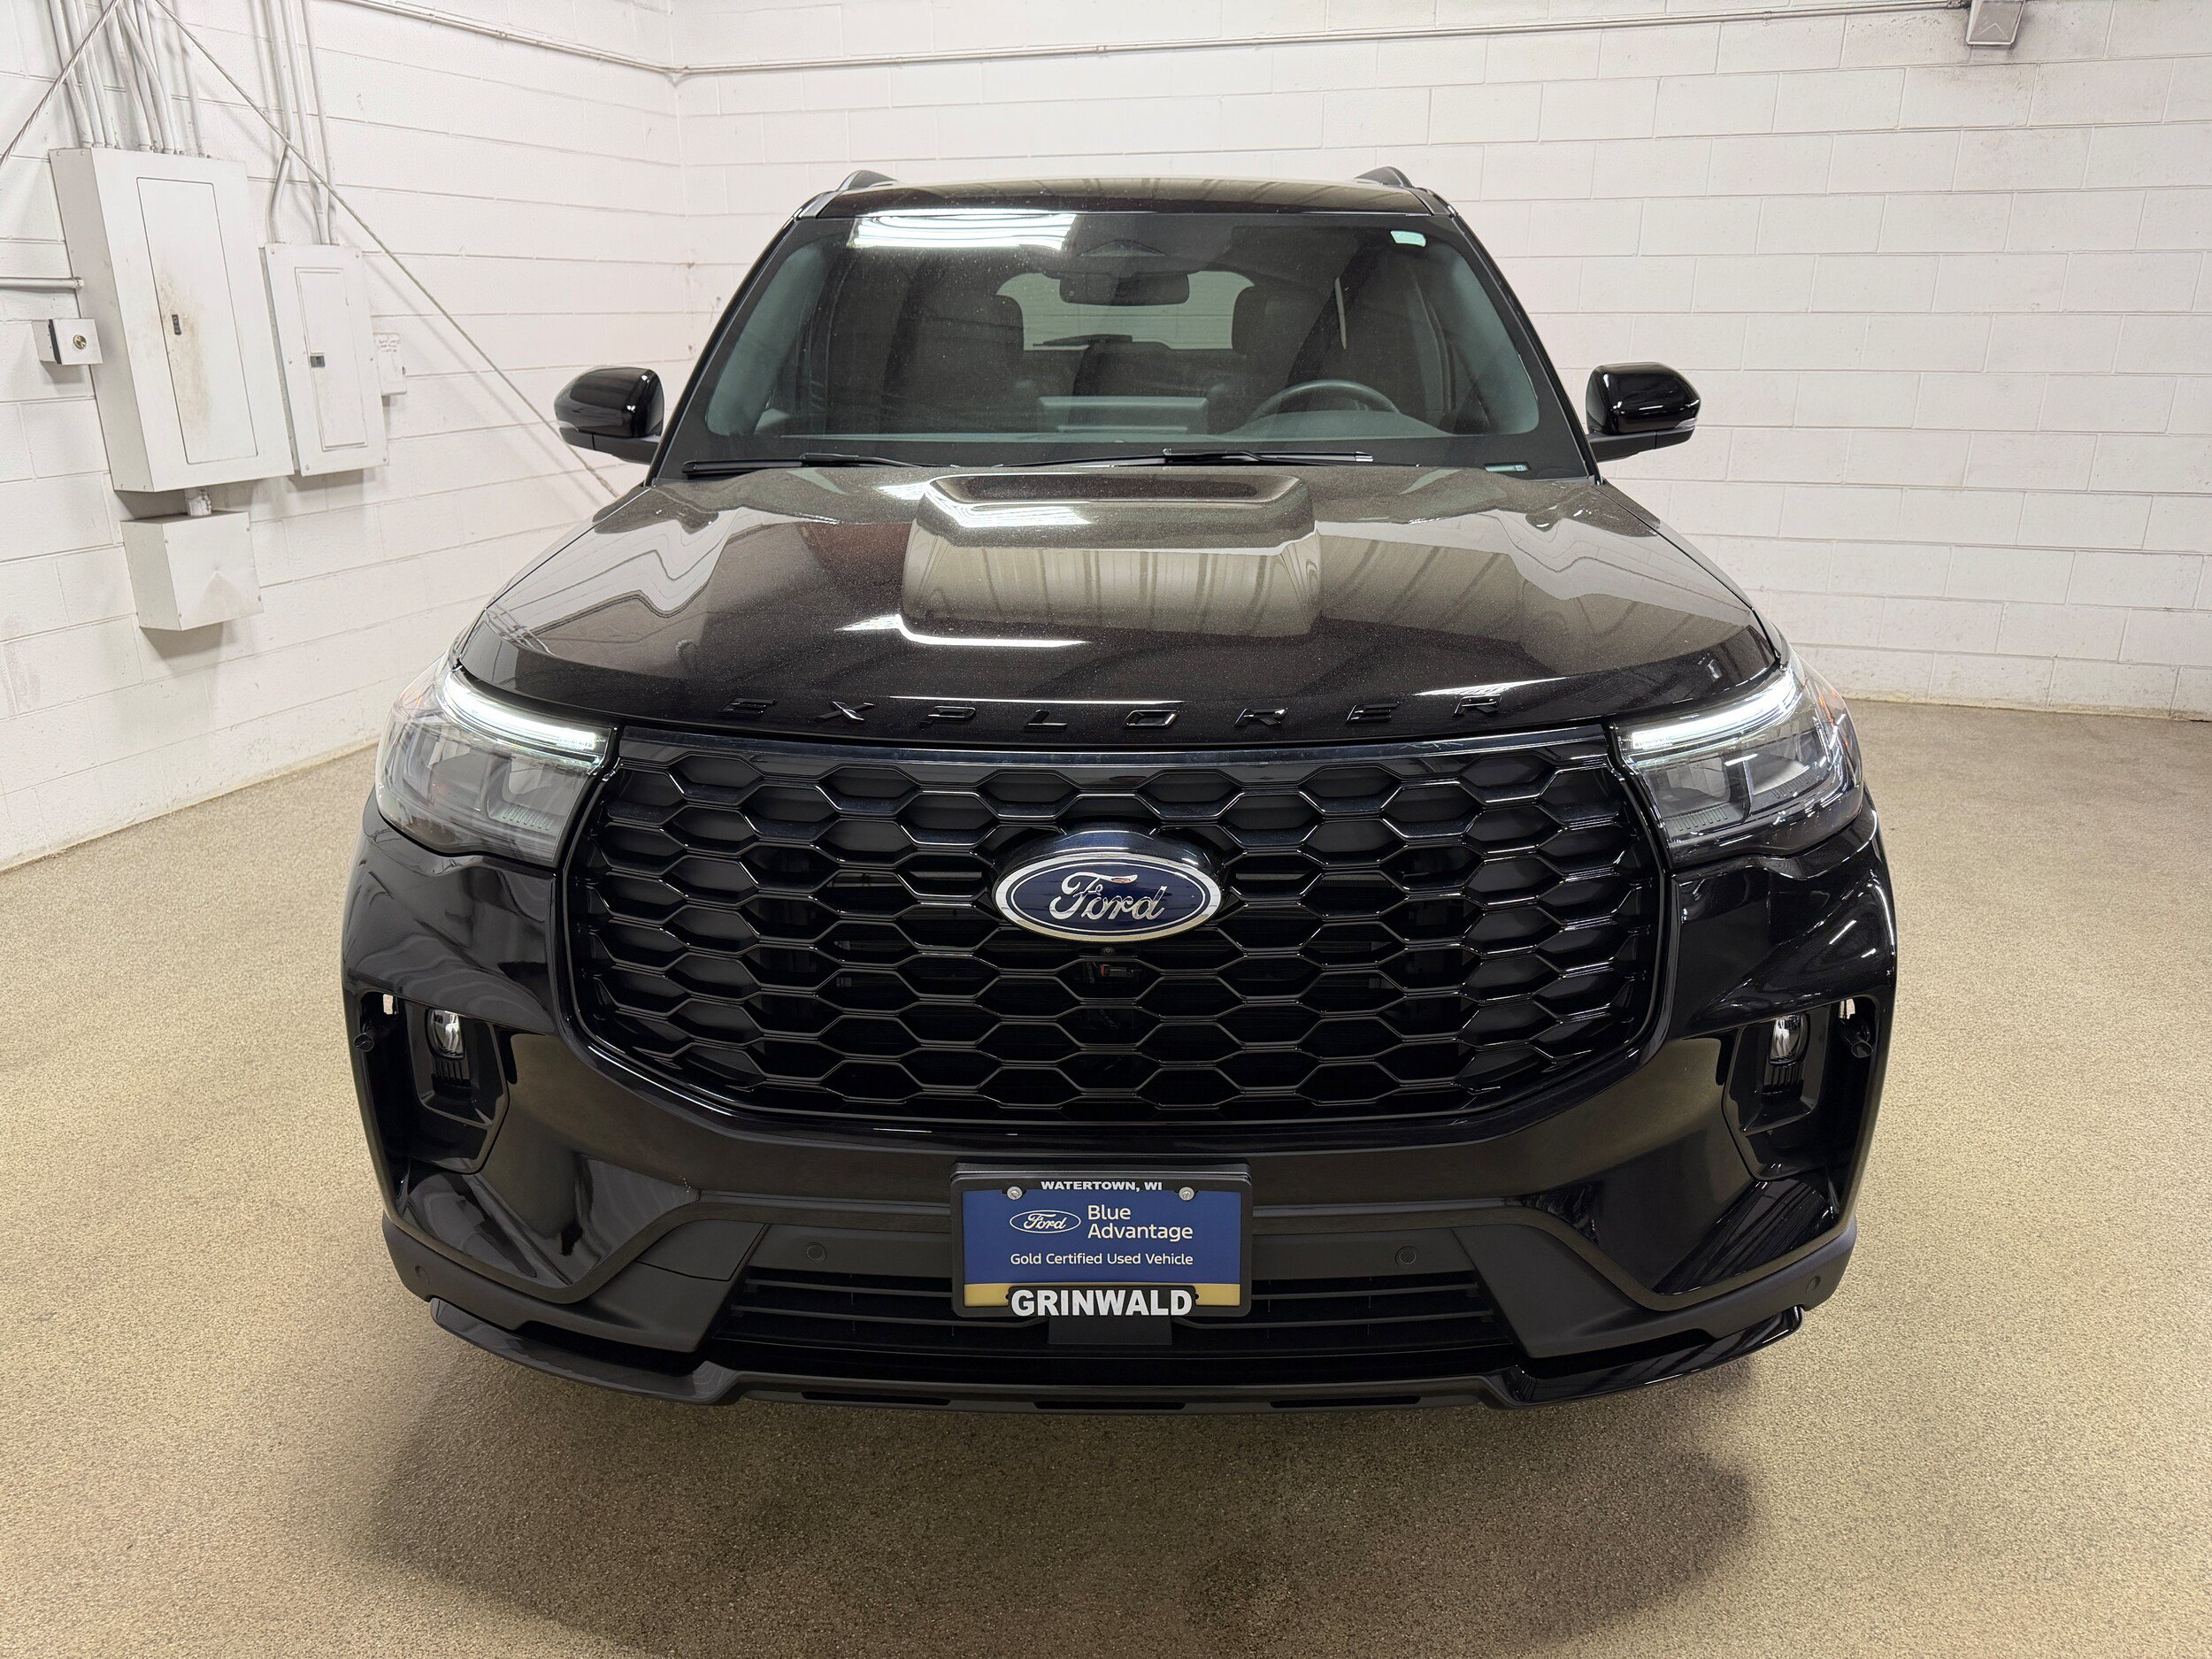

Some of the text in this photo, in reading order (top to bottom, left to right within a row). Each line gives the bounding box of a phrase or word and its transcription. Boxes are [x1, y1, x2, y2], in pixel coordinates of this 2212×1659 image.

[718, 695, 1503, 733] EXPLORER
[1049, 872, 1168, 920] Ford
[1041, 1181, 1163, 1192] WATERTOWN, WI
[1023, 1212, 1068, 1230] Ford
[1087, 1204, 1132, 1220] Blue
[1087, 1223, 1194, 1242] Advantage
[1010, 1253, 1194, 1265] Gold Certified Used Vehicle
[1010, 1289, 1193, 1317] GRINWALD
